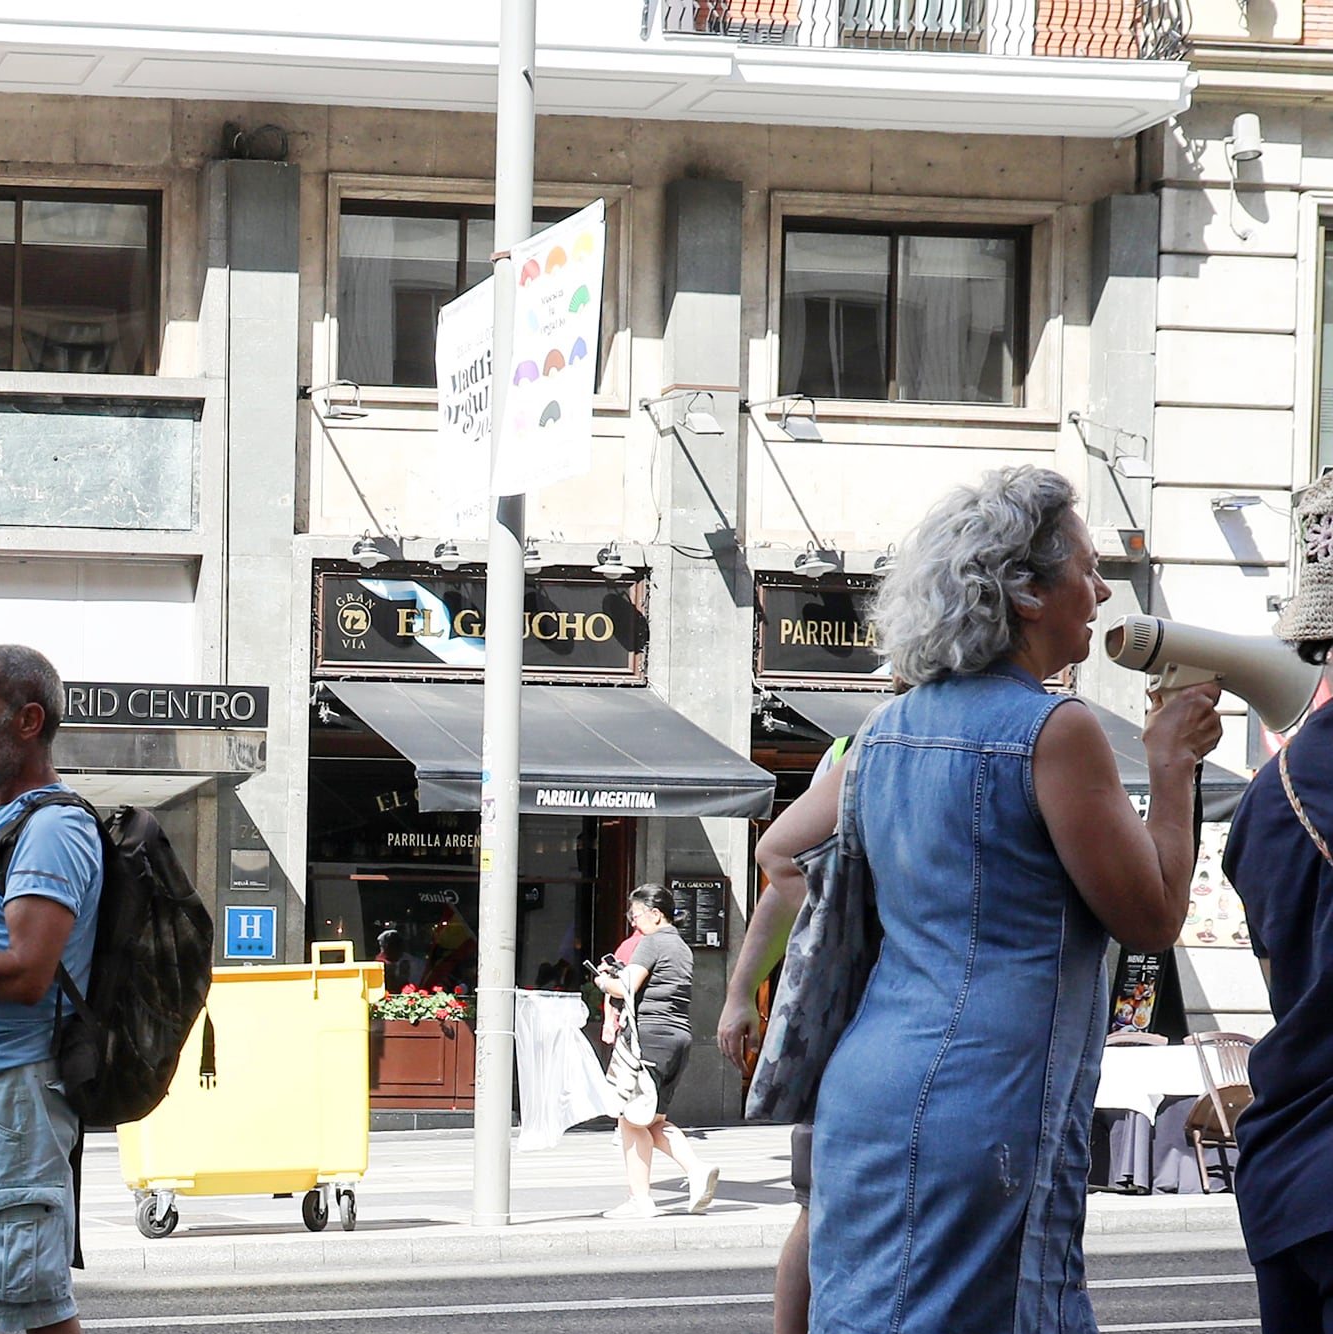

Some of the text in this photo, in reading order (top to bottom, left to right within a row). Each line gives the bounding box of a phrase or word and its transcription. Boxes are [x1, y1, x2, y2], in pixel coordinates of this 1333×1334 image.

[446, 349, 493, 397] Madri
[335, 592, 376, 609] GRAN
[342, 609, 367, 630] 72
[396, 608, 614, 642] EL GCHO
[779, 618, 878, 647] PARRILLA
[68, 687, 120, 718] RID
[127, 689, 257, 721] CENTRO
[376, 790, 408, 812] EL
[536, 789, 656, 809] PARRILLA ARGENTINA
[239, 824, 260, 839] 72
[387, 832, 482, 848] PARRILLA ARGEN
[237, 914, 263, 939] H
